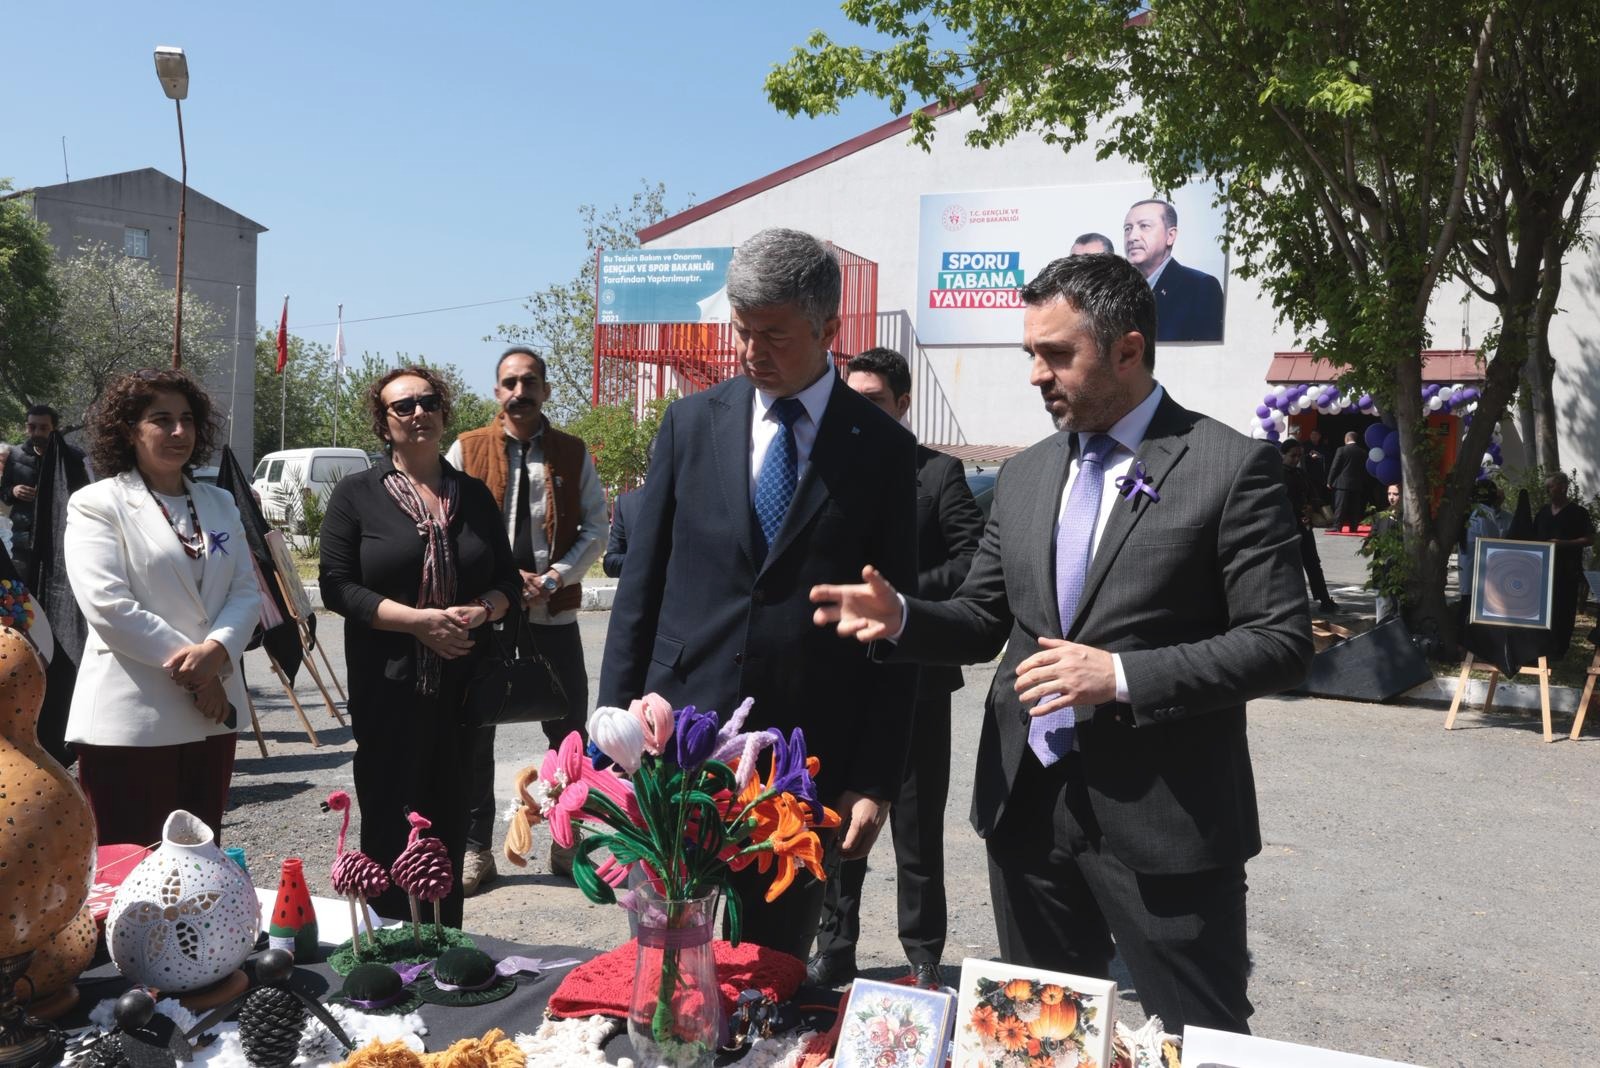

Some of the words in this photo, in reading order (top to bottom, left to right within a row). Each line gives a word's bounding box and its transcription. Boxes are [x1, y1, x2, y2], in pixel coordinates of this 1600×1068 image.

[603, 255, 613, 263] Bu
[614, 255, 638, 263] Tesisin
[639, 254, 662, 262] Bakım
[673, 253, 702, 261] Onarımı
[948, 253, 1010, 270] SPORU
[637, 263, 647, 272] VE
[648, 263, 670, 272] SPOR
[671, 260, 714, 272] BAKANLIĞI
[603, 275, 645, 284] Tarafından
[647, 274, 702, 284] Yaptırılmıştır.
[943, 271, 1017, 289] TABANA
[601, 314, 619, 323] 2021
